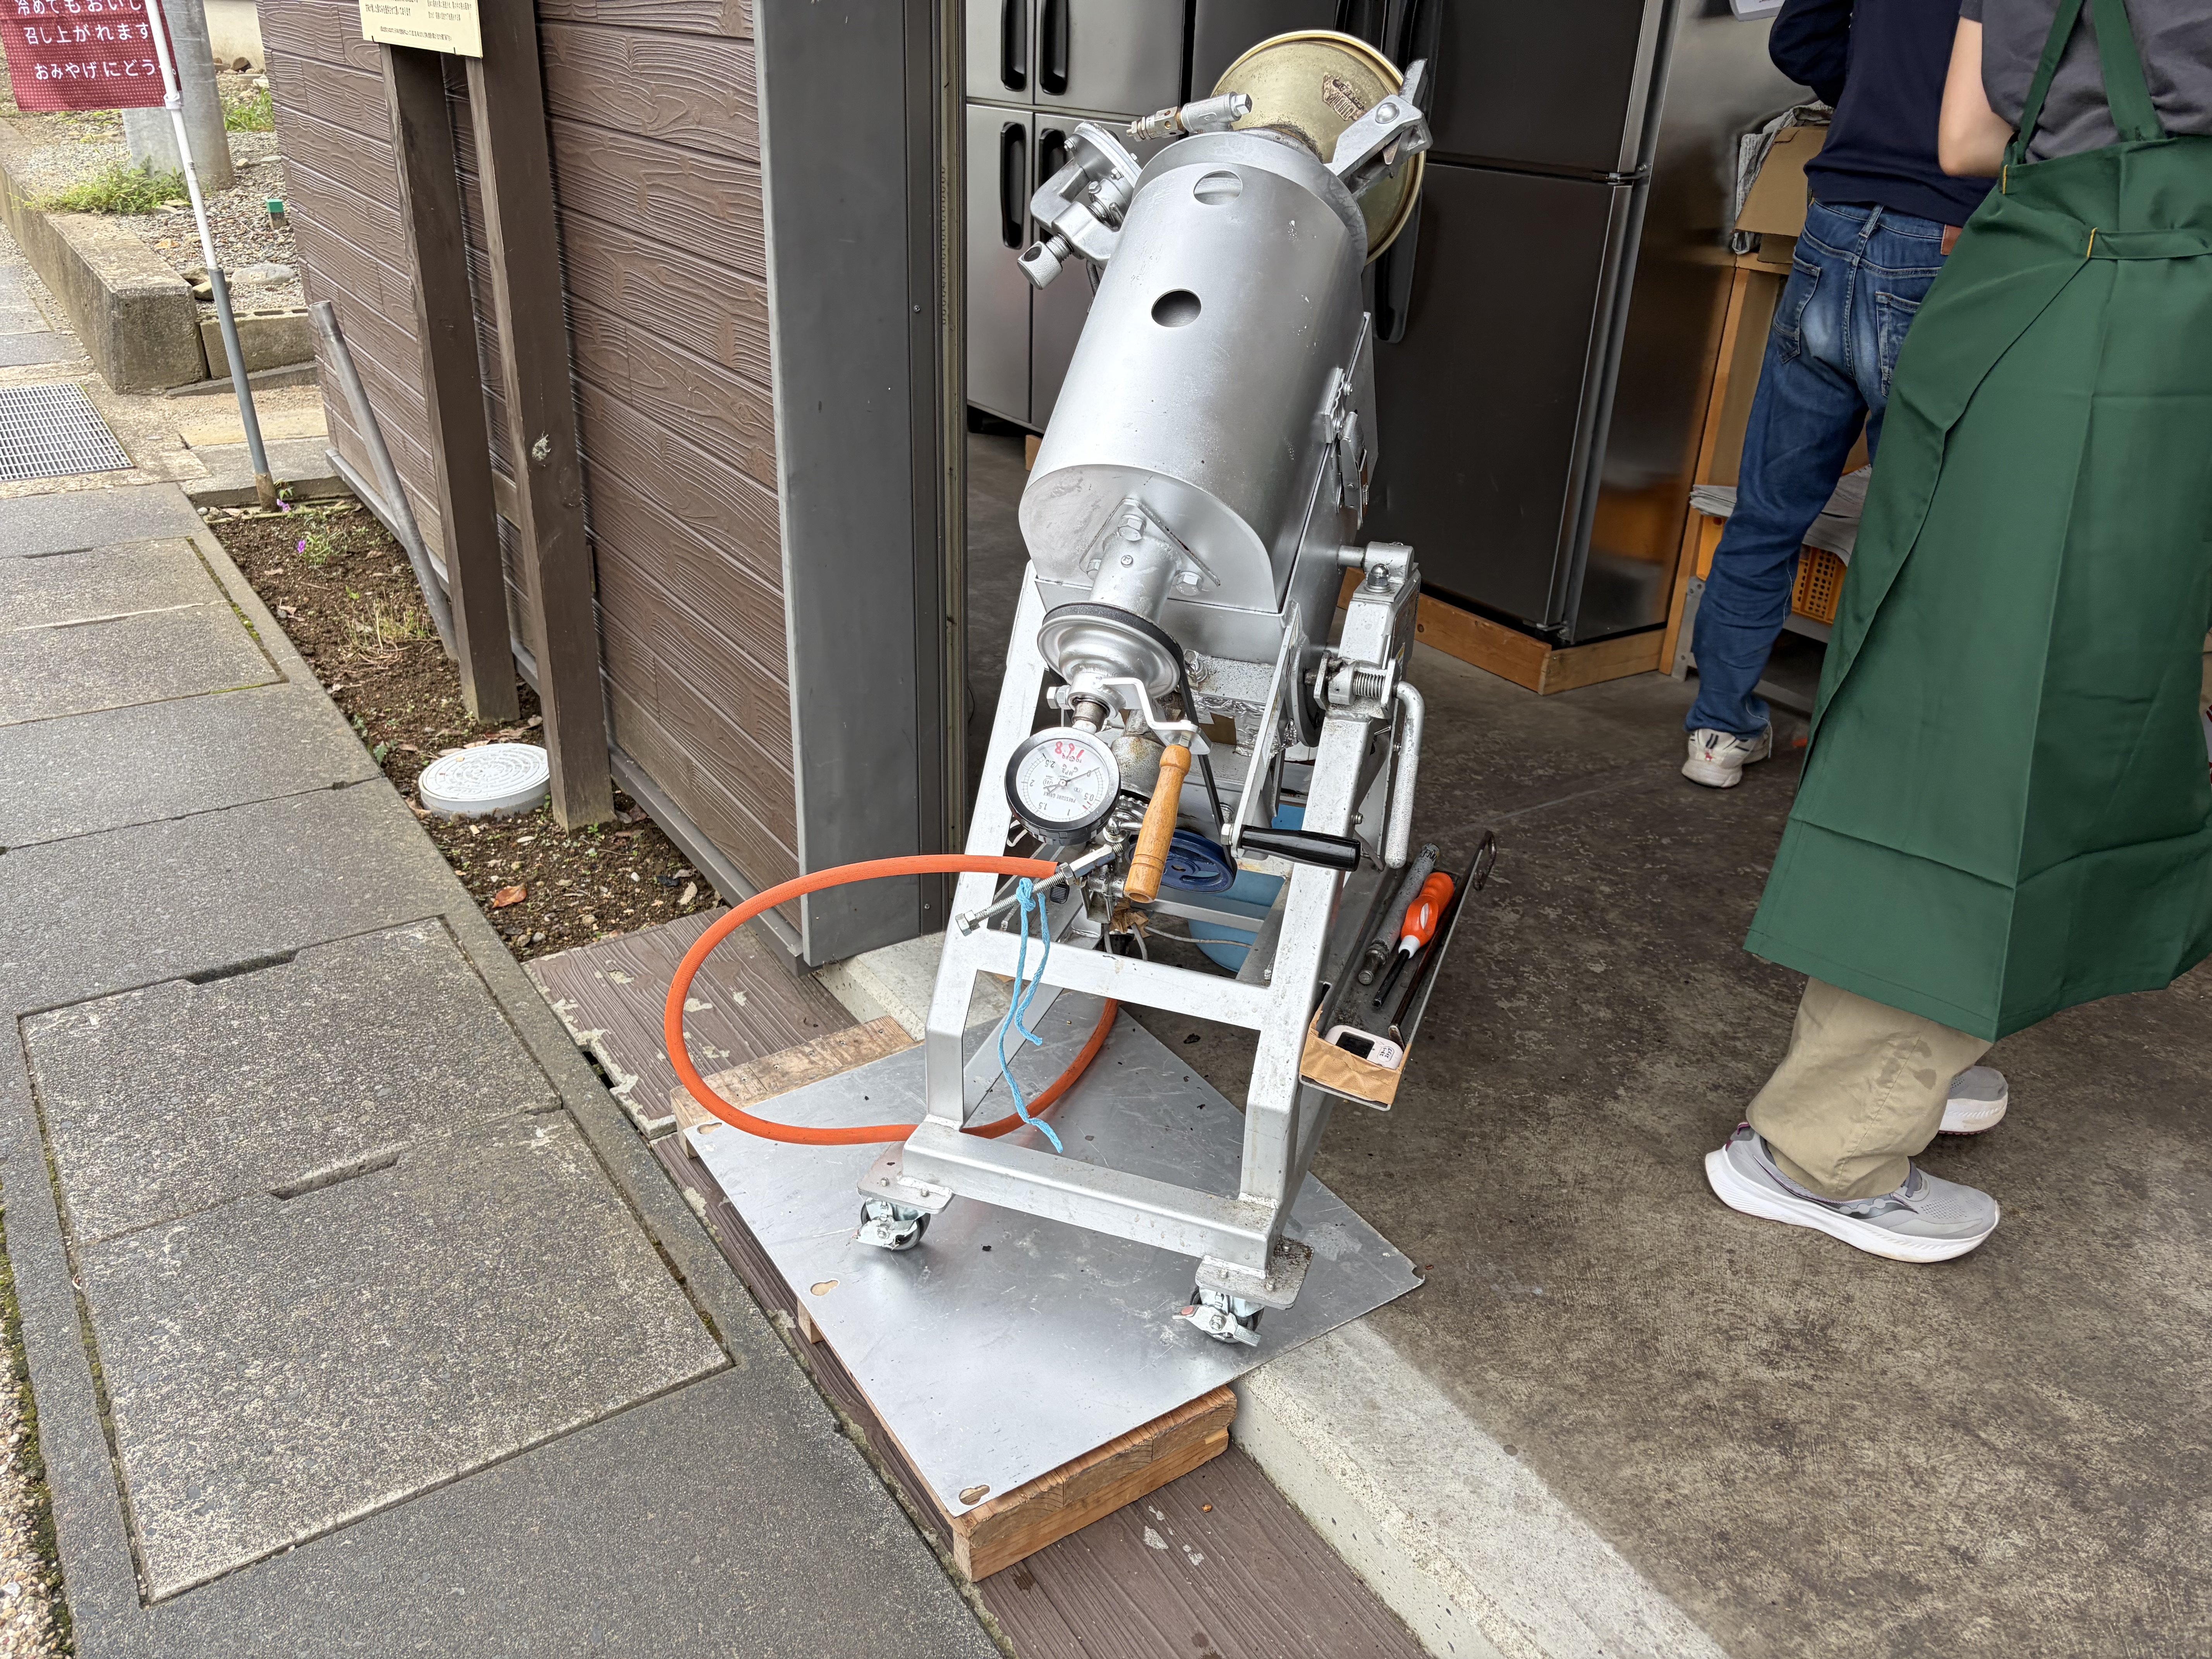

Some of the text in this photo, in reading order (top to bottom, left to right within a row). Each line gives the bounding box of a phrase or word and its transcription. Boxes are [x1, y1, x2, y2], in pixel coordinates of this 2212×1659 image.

[24, 22, 149, 45] 召し上がれます
[34, 59, 176, 80] おみやげにどう。
[1044, 759, 1056, 769] 2.5
[1056, 794, 1077, 804] PRESSURE
[1084, 792, 1094, 802] 0.5
[1038, 801, 1048, 811] 1.5
